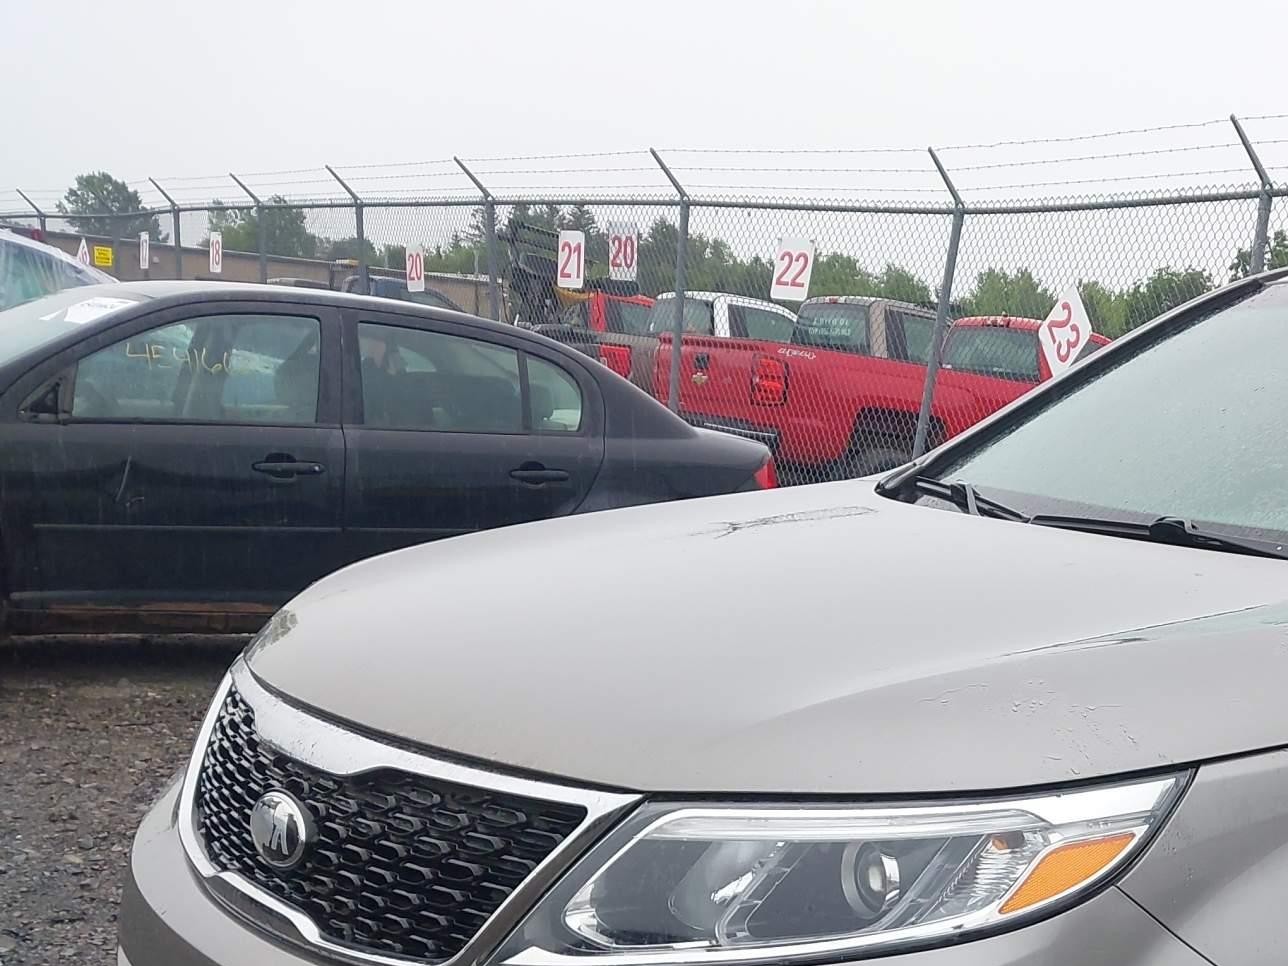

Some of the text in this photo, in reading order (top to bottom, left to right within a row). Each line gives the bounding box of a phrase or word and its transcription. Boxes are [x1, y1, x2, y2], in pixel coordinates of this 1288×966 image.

[210, 239, 221, 266] 18
[408, 253, 423, 281] 20
[559, 240, 582, 279] 21
[611, 235, 635, 269] 20
[775, 250, 809, 288] 22
[1047, 301, 1080, 363] 23
